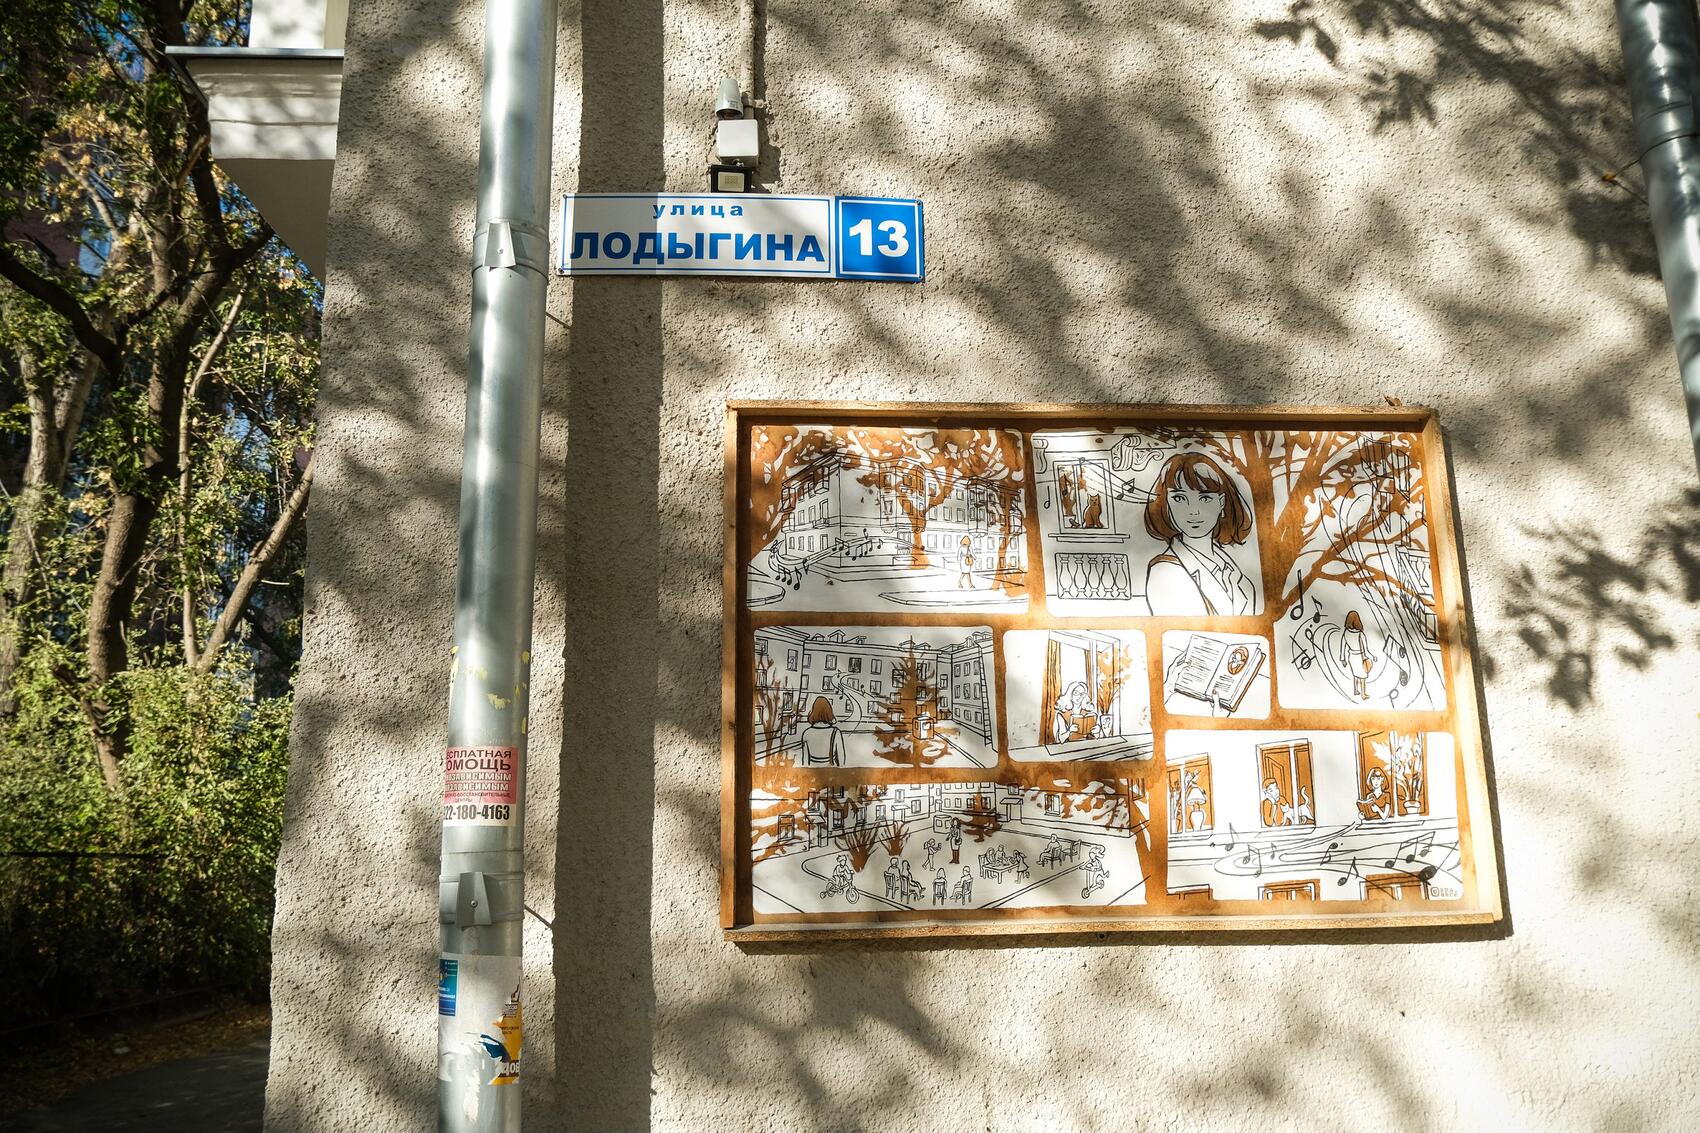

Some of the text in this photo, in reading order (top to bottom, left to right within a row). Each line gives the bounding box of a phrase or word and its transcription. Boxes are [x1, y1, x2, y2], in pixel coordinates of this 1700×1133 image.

[653, 203, 743, 218] улица
[570, 218, 909, 265] ЛОДЫГИНА 13
[446, 749, 512, 759] ЕСПЛАТНАЯ
[446, 758, 511, 772] ОМОЩЬ
